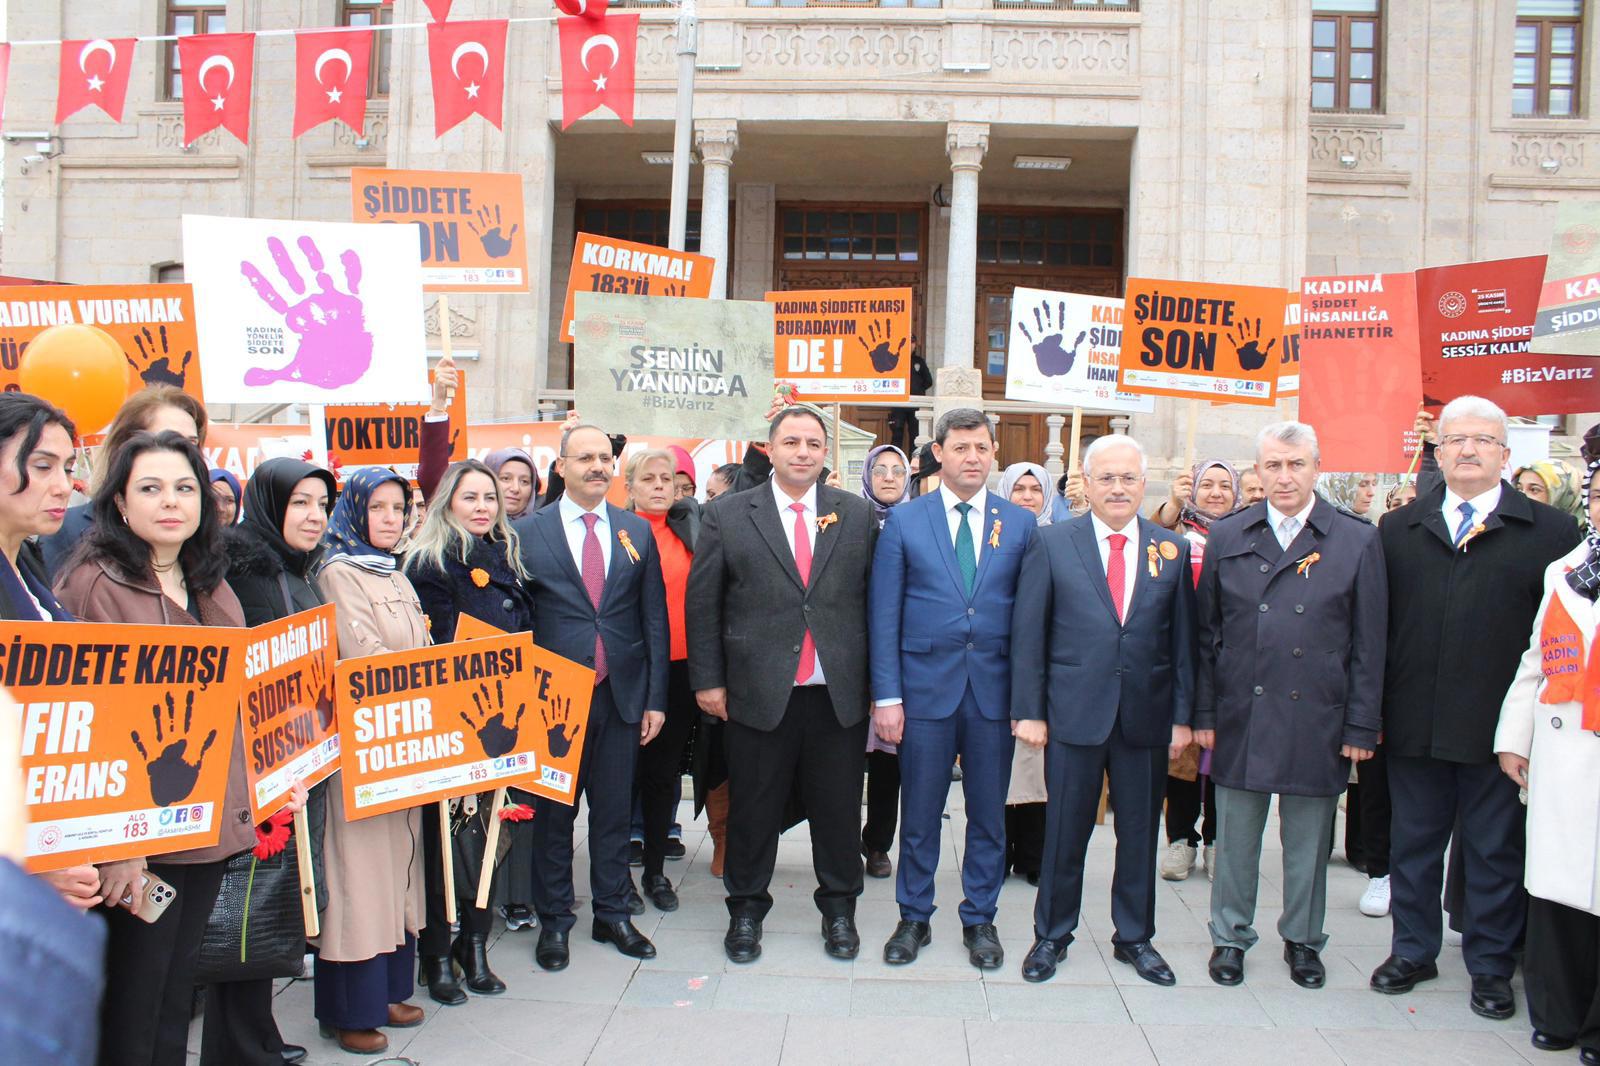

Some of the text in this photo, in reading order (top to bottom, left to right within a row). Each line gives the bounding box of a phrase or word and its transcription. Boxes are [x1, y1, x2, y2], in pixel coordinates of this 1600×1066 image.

[363, 181, 472, 218] ŞİDDETE
[582, 242, 693, 281] KORKMA!
[1304, 279, 1383, 295] KADINA
[0, 298, 184, 327] ADINA VURMAK
[775, 299, 905, 317] KADINA ŞİDDETE KARŞI
[1134, 290, 1235, 326] ŞİDDETE
[1312, 298, 1357, 309] ŞİDDET
[1091, 304, 1122, 324] KAD
[1303, 306, 1389, 322] İNSANLIĞA
[1550, 308, 1600, 331] ŞİDD
[775, 319, 856, 335] BURADAYIM
[1304, 325, 1393, 340] İHANETTİR
[1441, 329, 1489, 342] KADINA
[248, 346, 285, 354] SON
[788, 339, 825, 373] DE
[1140, 327, 1218, 371] SON
[1442, 342, 1487, 358] SESSİZ
[1501, 366, 1593, 384] #BizVarız
[1095, 390, 1109, 398] 183
[1213, 382, 1229, 393] 183
[643, 396, 715, 411] #BizVarız
[245, 643, 270, 680] SEN
[271, 622, 307, 668] BAĞIR
[308, 615, 322, 653] Kİ
[0, 635, 229, 691] İDDETE KARŞI
[349, 647, 522, 704] ŞİDDETE KARŞI
[248, 671, 303, 735] ŞİDDET
[353, 697, 433, 743] SIFIR
[252, 710, 315, 774] SUSSUN
[355, 731, 465, 775] TOLERANS
[22, 759, 128, 806] ERANS
[468, 769, 488, 781] 183
[128, 813, 146, 822] ALO
[123, 822, 149, 839] 183
